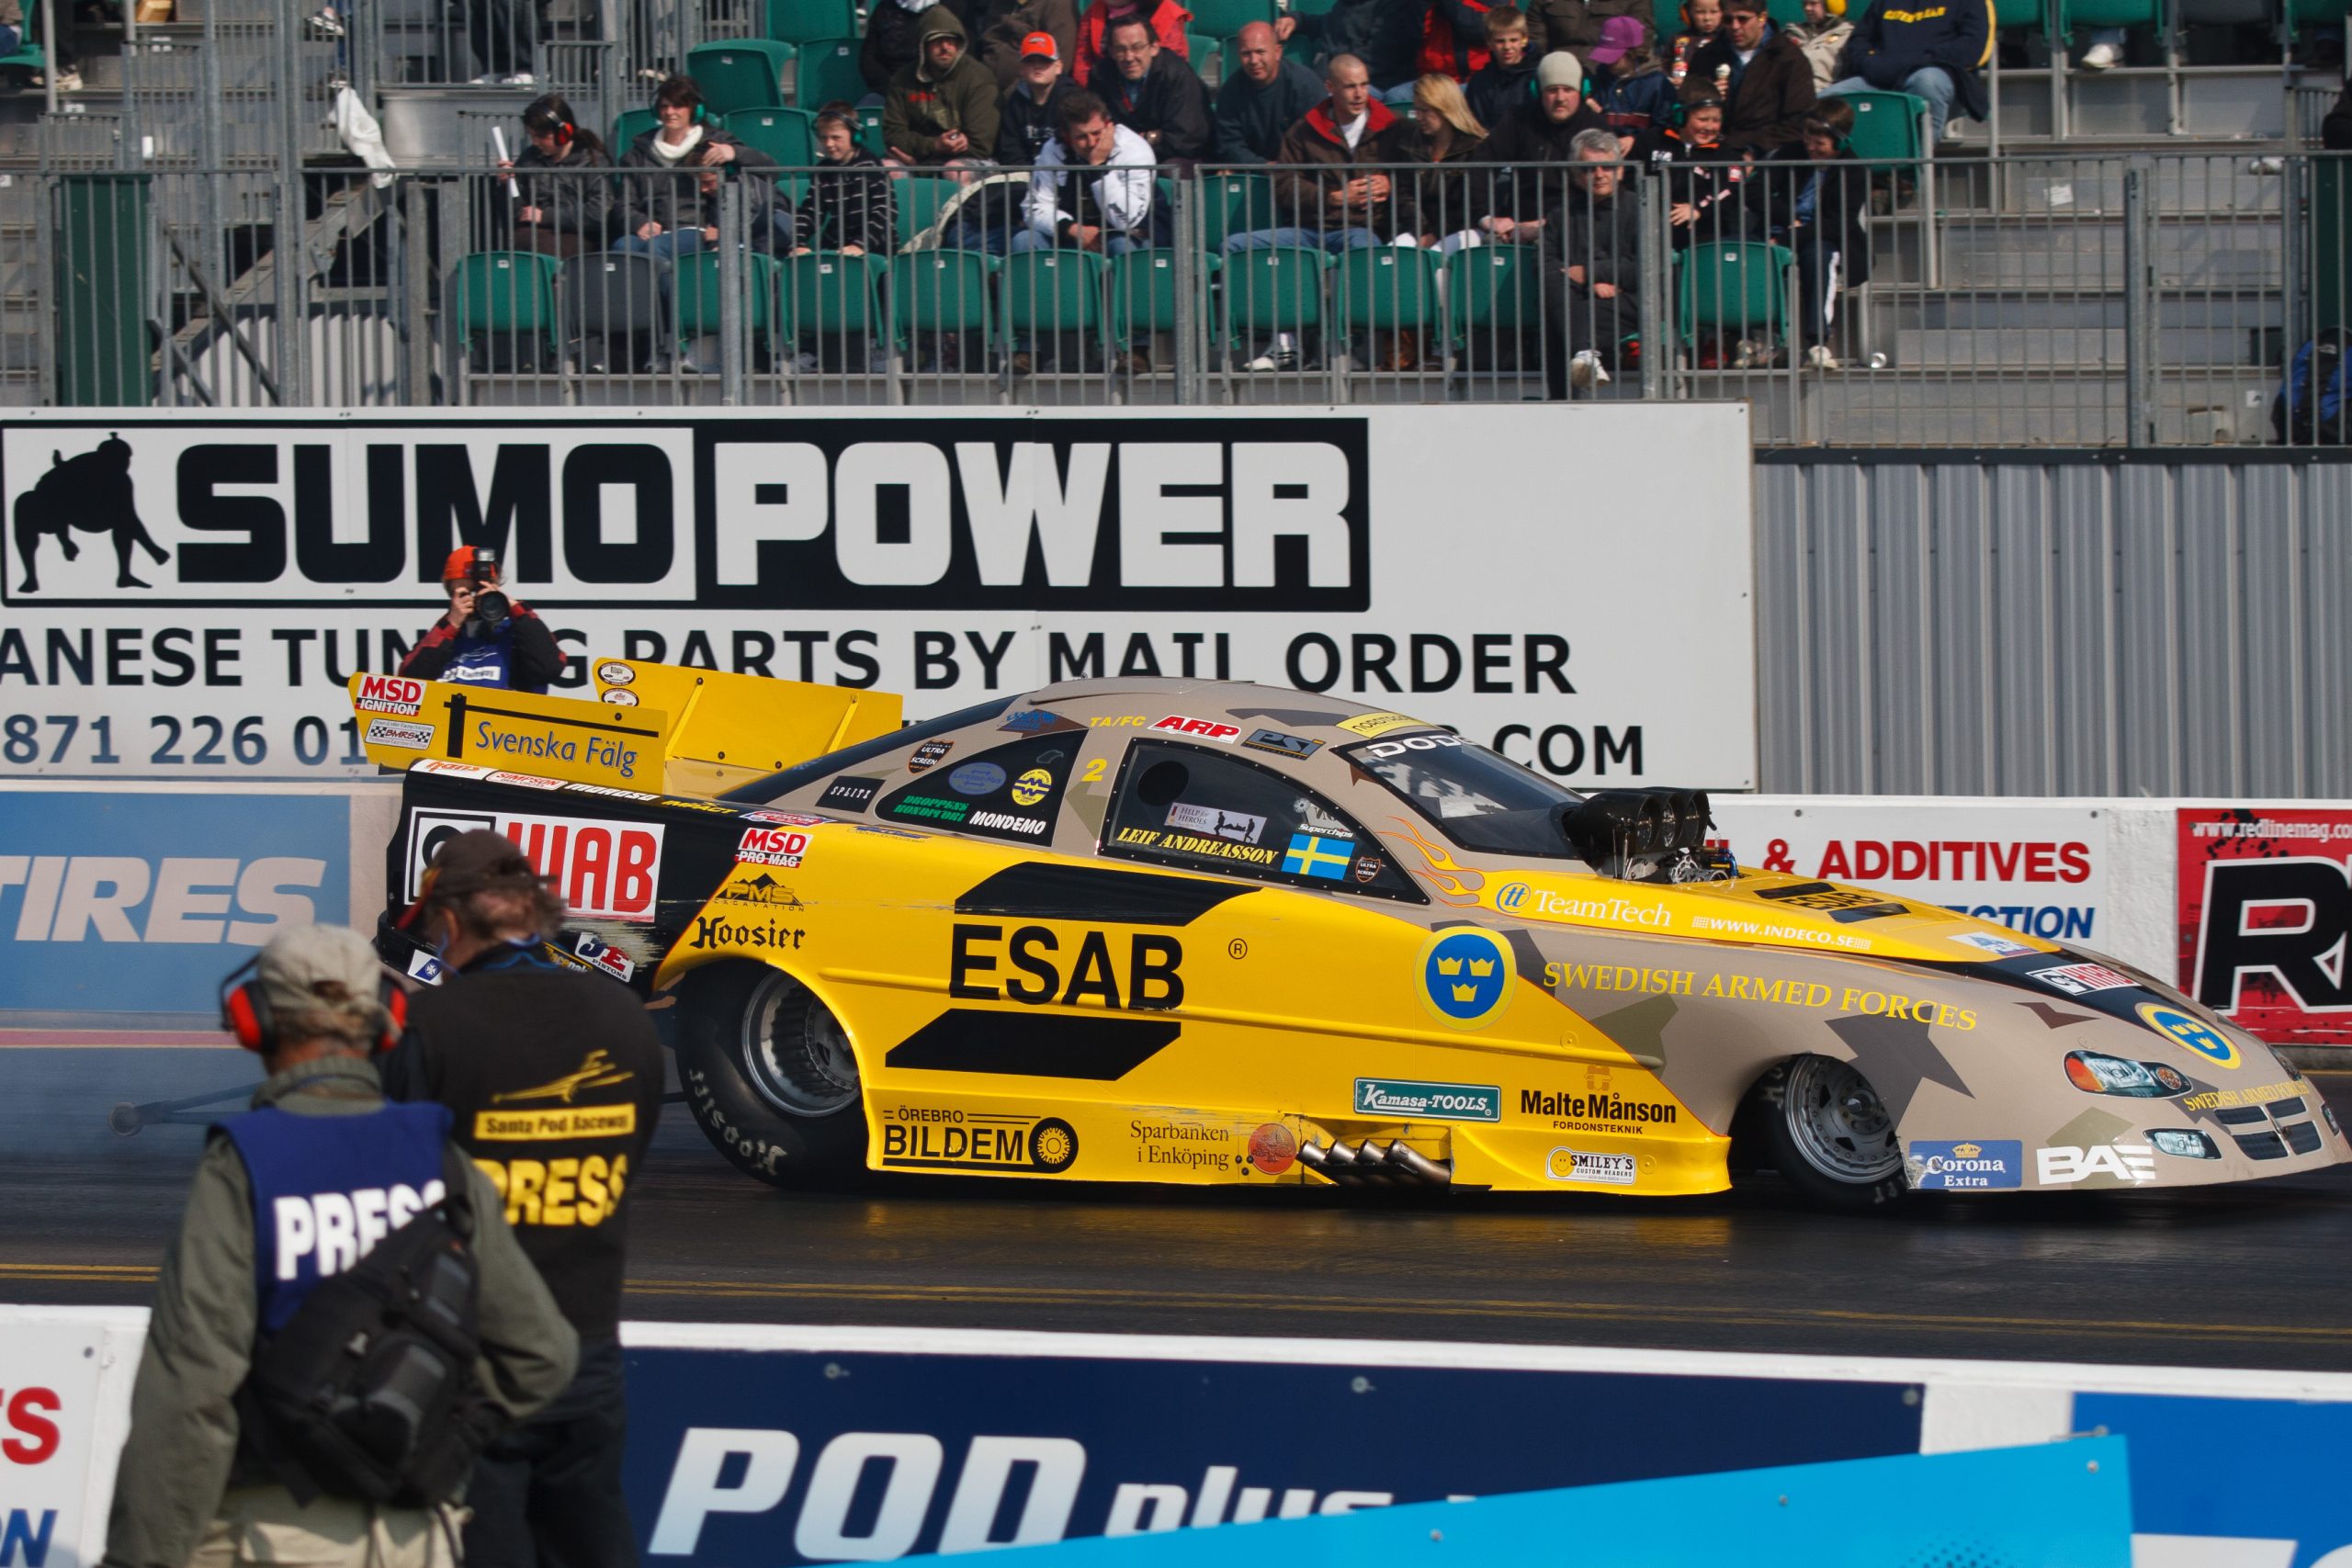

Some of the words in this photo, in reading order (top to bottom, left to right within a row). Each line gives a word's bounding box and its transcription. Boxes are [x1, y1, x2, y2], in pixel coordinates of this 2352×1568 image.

[176, 443, 673, 584] SUMO
[714, 442, 1351, 588] POWER
[271, 627, 591, 689] TUNG
[624, 628, 880, 691] PARTS
[914, 630, 1016, 690] BY
[1285, 632, 1577, 694] ORDER
[362, 676, 422, 704] MSD
[359, 699, 417, 716] IGNITION
[385, 728, 416, 739] BMRS
[1090, 716, 1147, 728] TA/FC
[1150, 716, 1240, 739] ARP
[4, 714, 119, 766] 871
[151, 714, 267, 766] 226
[476, 721, 576, 761] Svenska
[586, 738, 638, 779] Fälg
[921, 746, 945, 754] ULTRA
[910, 756, 937, 765] SCREEN
[1081, 758, 1108, 783] 2
[496, 773, 559, 786] SIMPSON
[1178, 814, 1207, 825] HEROES
[1181, 807, 1200, 816] HELP
[741, 829, 807, 854] MSD
[1298, 823, 1353, 838] Superchips
[1116, 827, 1159, 847] LEIF
[1161, 834, 1279, 865] ANDREASSON
[738, 851, 765, 863] PRO
[767, 853, 798, 868] MAG
[1763, 839, 1796, 874] &
[1817, 840, 2090, 884] ADDITIVES
[726, 882, 795, 904] PMS
[1778, 892, 1885, 911] ESAB
[1534, 888, 1672, 928] TeamTech
[689, 915, 807, 950] Hoosier
[1709, 918, 1856, 948] WWW.INDECO.SE
[578, 938, 630, 973] JE
[949, 922, 1184, 1010] ESAB
[592, 958, 628, 980] PISTONS
[1543, 961, 1693, 997] SWEDISH
[1701, 973, 1832, 1009] ARMED
[1838, 987, 1978, 1031] FORCES
[1363, 1084, 1488, 1112] Kamasa-TOOLS
[1521, 1089, 1584, 1118] Malte
[1588, 1092, 1677, 1123] Månson
[2183, 1089, 2240, 1111] SWEDISH
[2241, 1084, 2278, 1103] ARMED
[486, 1117, 534, 1134] Santa
[537, 1116, 569, 1134] Pod
[899, 1105, 965, 1124] ÖREBRO
[1130, 1120, 1230, 1143] Sparbanken
[1553, 1121, 1643, 1134] FORDONSTEKNIK
[1137, 1145, 1143, 1164] i
[1147, 1145, 1230, 1171] Enköping
[1570, 1155, 1634, 1170] SMILEY'S
[1926, 1155, 2007, 1176] Corona
[2036, 1145, 2156, 1186] BAE
[1604, 1169, 1633, 1178] HEADERS
[1943, 1174, 1989, 1188] Extra
[274, 1179, 447, 1280] PRES
[647, 1427, 1086, 1562] POD
[1103, 1466, 1393, 1539] plu
